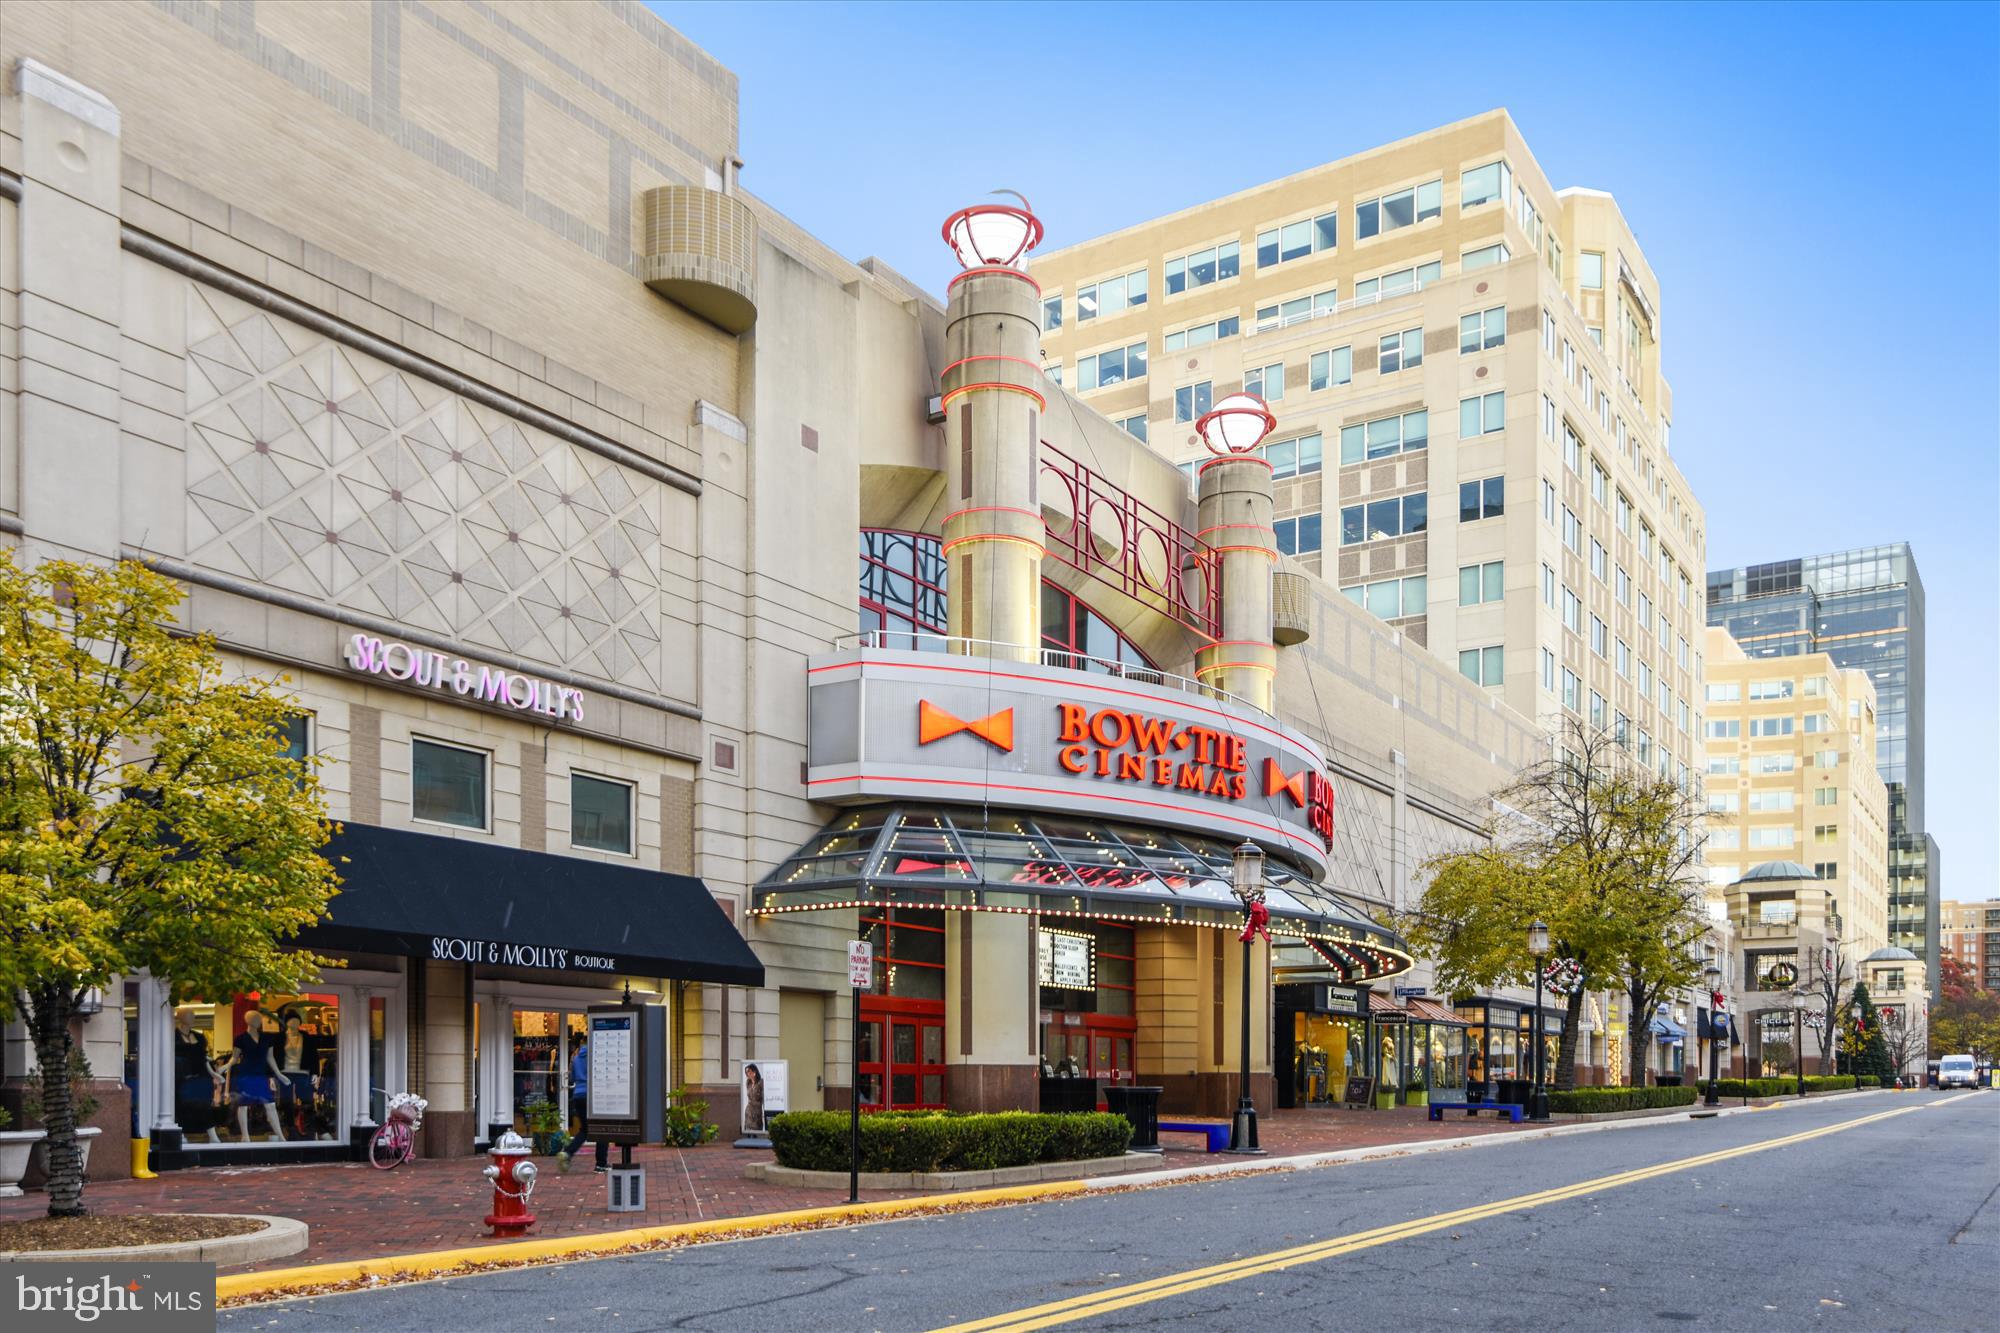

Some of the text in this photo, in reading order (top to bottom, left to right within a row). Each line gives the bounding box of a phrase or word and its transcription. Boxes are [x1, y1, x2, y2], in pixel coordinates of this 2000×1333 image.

[350, 634, 584, 722] SCOUT & MOLLY'S
[1059, 745, 1246, 799] CINEMAS
[432, 937, 615, 970] SCOUT & MOLLY'S BOUTIQUE
[851, 955, 869, 965] PARKING
[856, 946, 864, 954] NO
